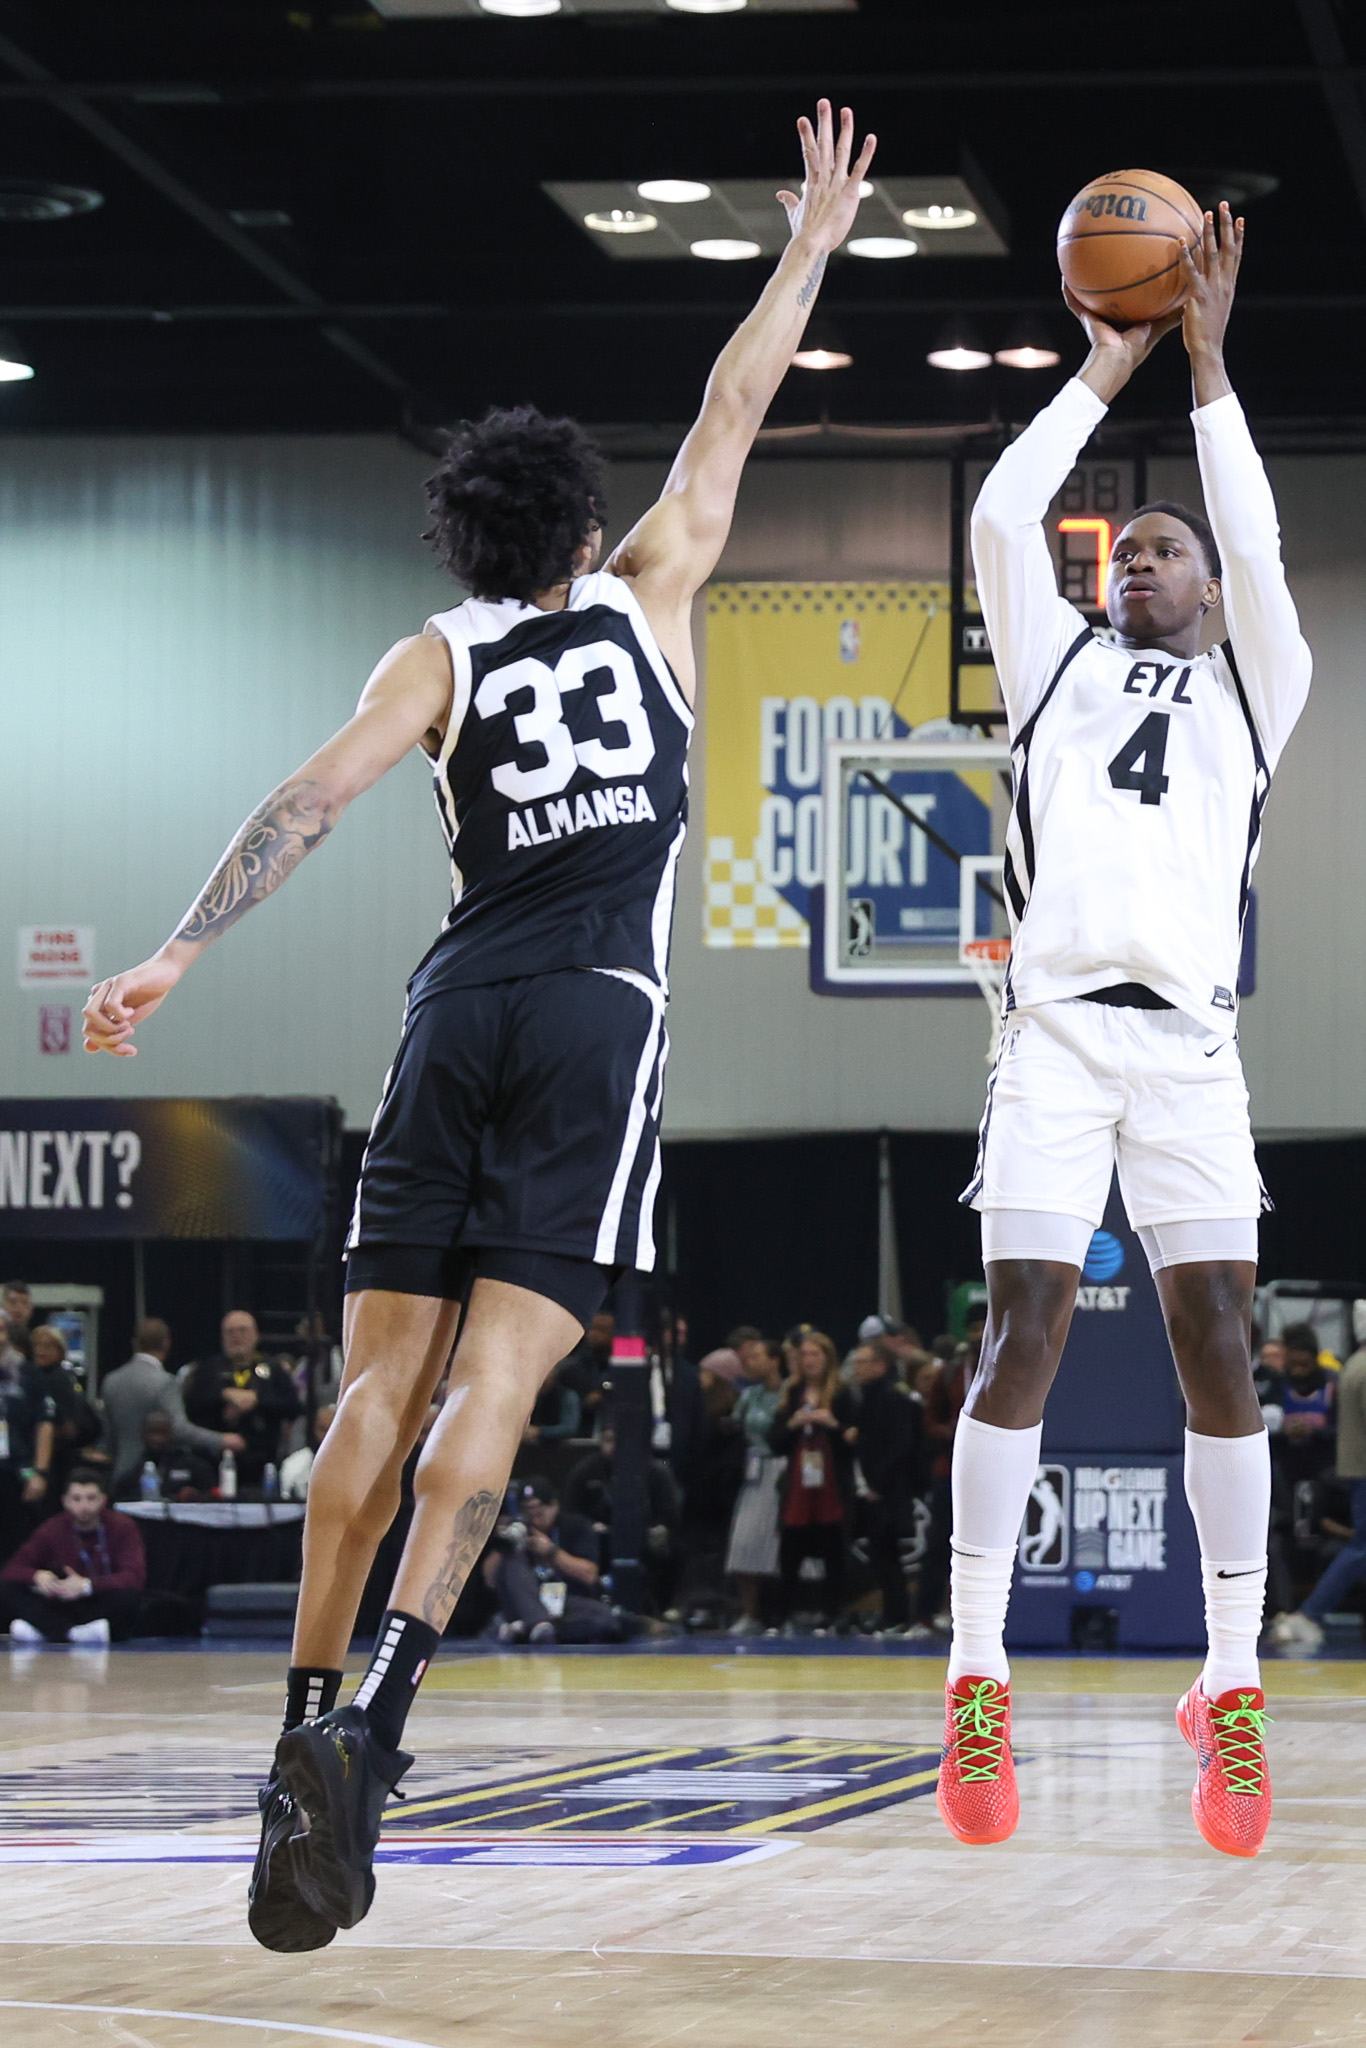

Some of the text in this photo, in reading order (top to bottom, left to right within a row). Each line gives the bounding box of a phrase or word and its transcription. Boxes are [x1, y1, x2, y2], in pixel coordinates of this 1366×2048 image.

[1066, 193, 1147, 222] Wilso
[1058, 516, 1111, 608] 7
[1123, 661, 1193, 704] EYL
[474, 639, 656, 803] 33
[1107, 711, 1170, 806] 4
[508, 785, 657, 851] ALMANSA
[0, 1130, 141, 1209] NEXT?
[1074, 1489, 1167, 1530] UP NEXT
[1107, 1530, 1167, 1571] GAME
